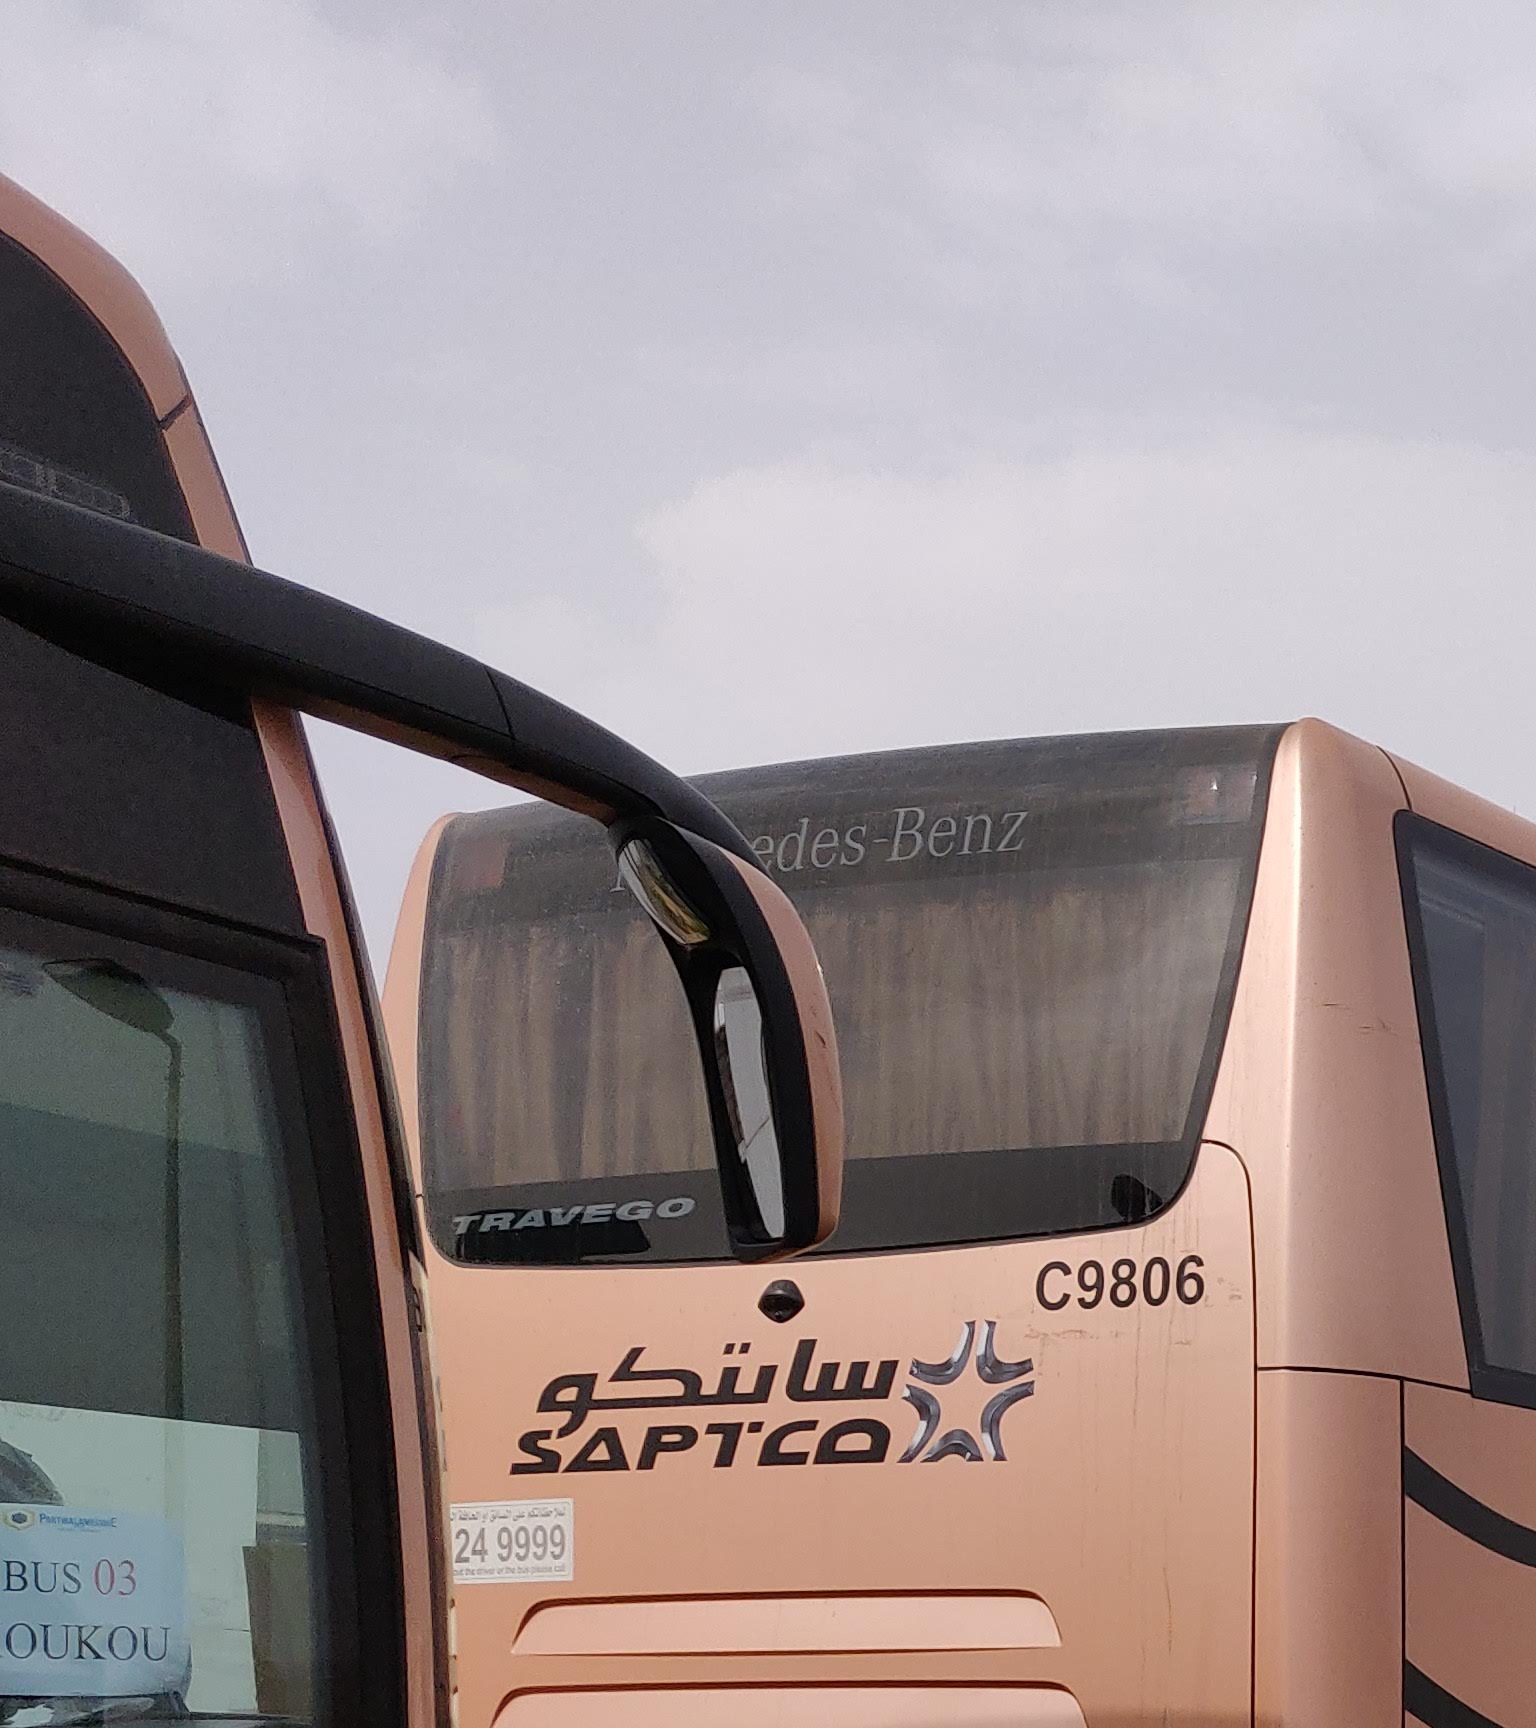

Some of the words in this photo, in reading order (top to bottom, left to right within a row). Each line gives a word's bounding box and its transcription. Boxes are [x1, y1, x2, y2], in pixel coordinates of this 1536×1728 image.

[452, 1197, 696, 1236] TRAVEGO
[1035, 1254, 1206, 1311] C9806
[509, 1418, 892, 1475] SAPTCO
[497, 1524, 566, 1562] 9999
[3, 1559, 82, 1594] BUS
[94, 1558, 137, 1596] 03
[0, 1622, 171, 1662] OUKOU
